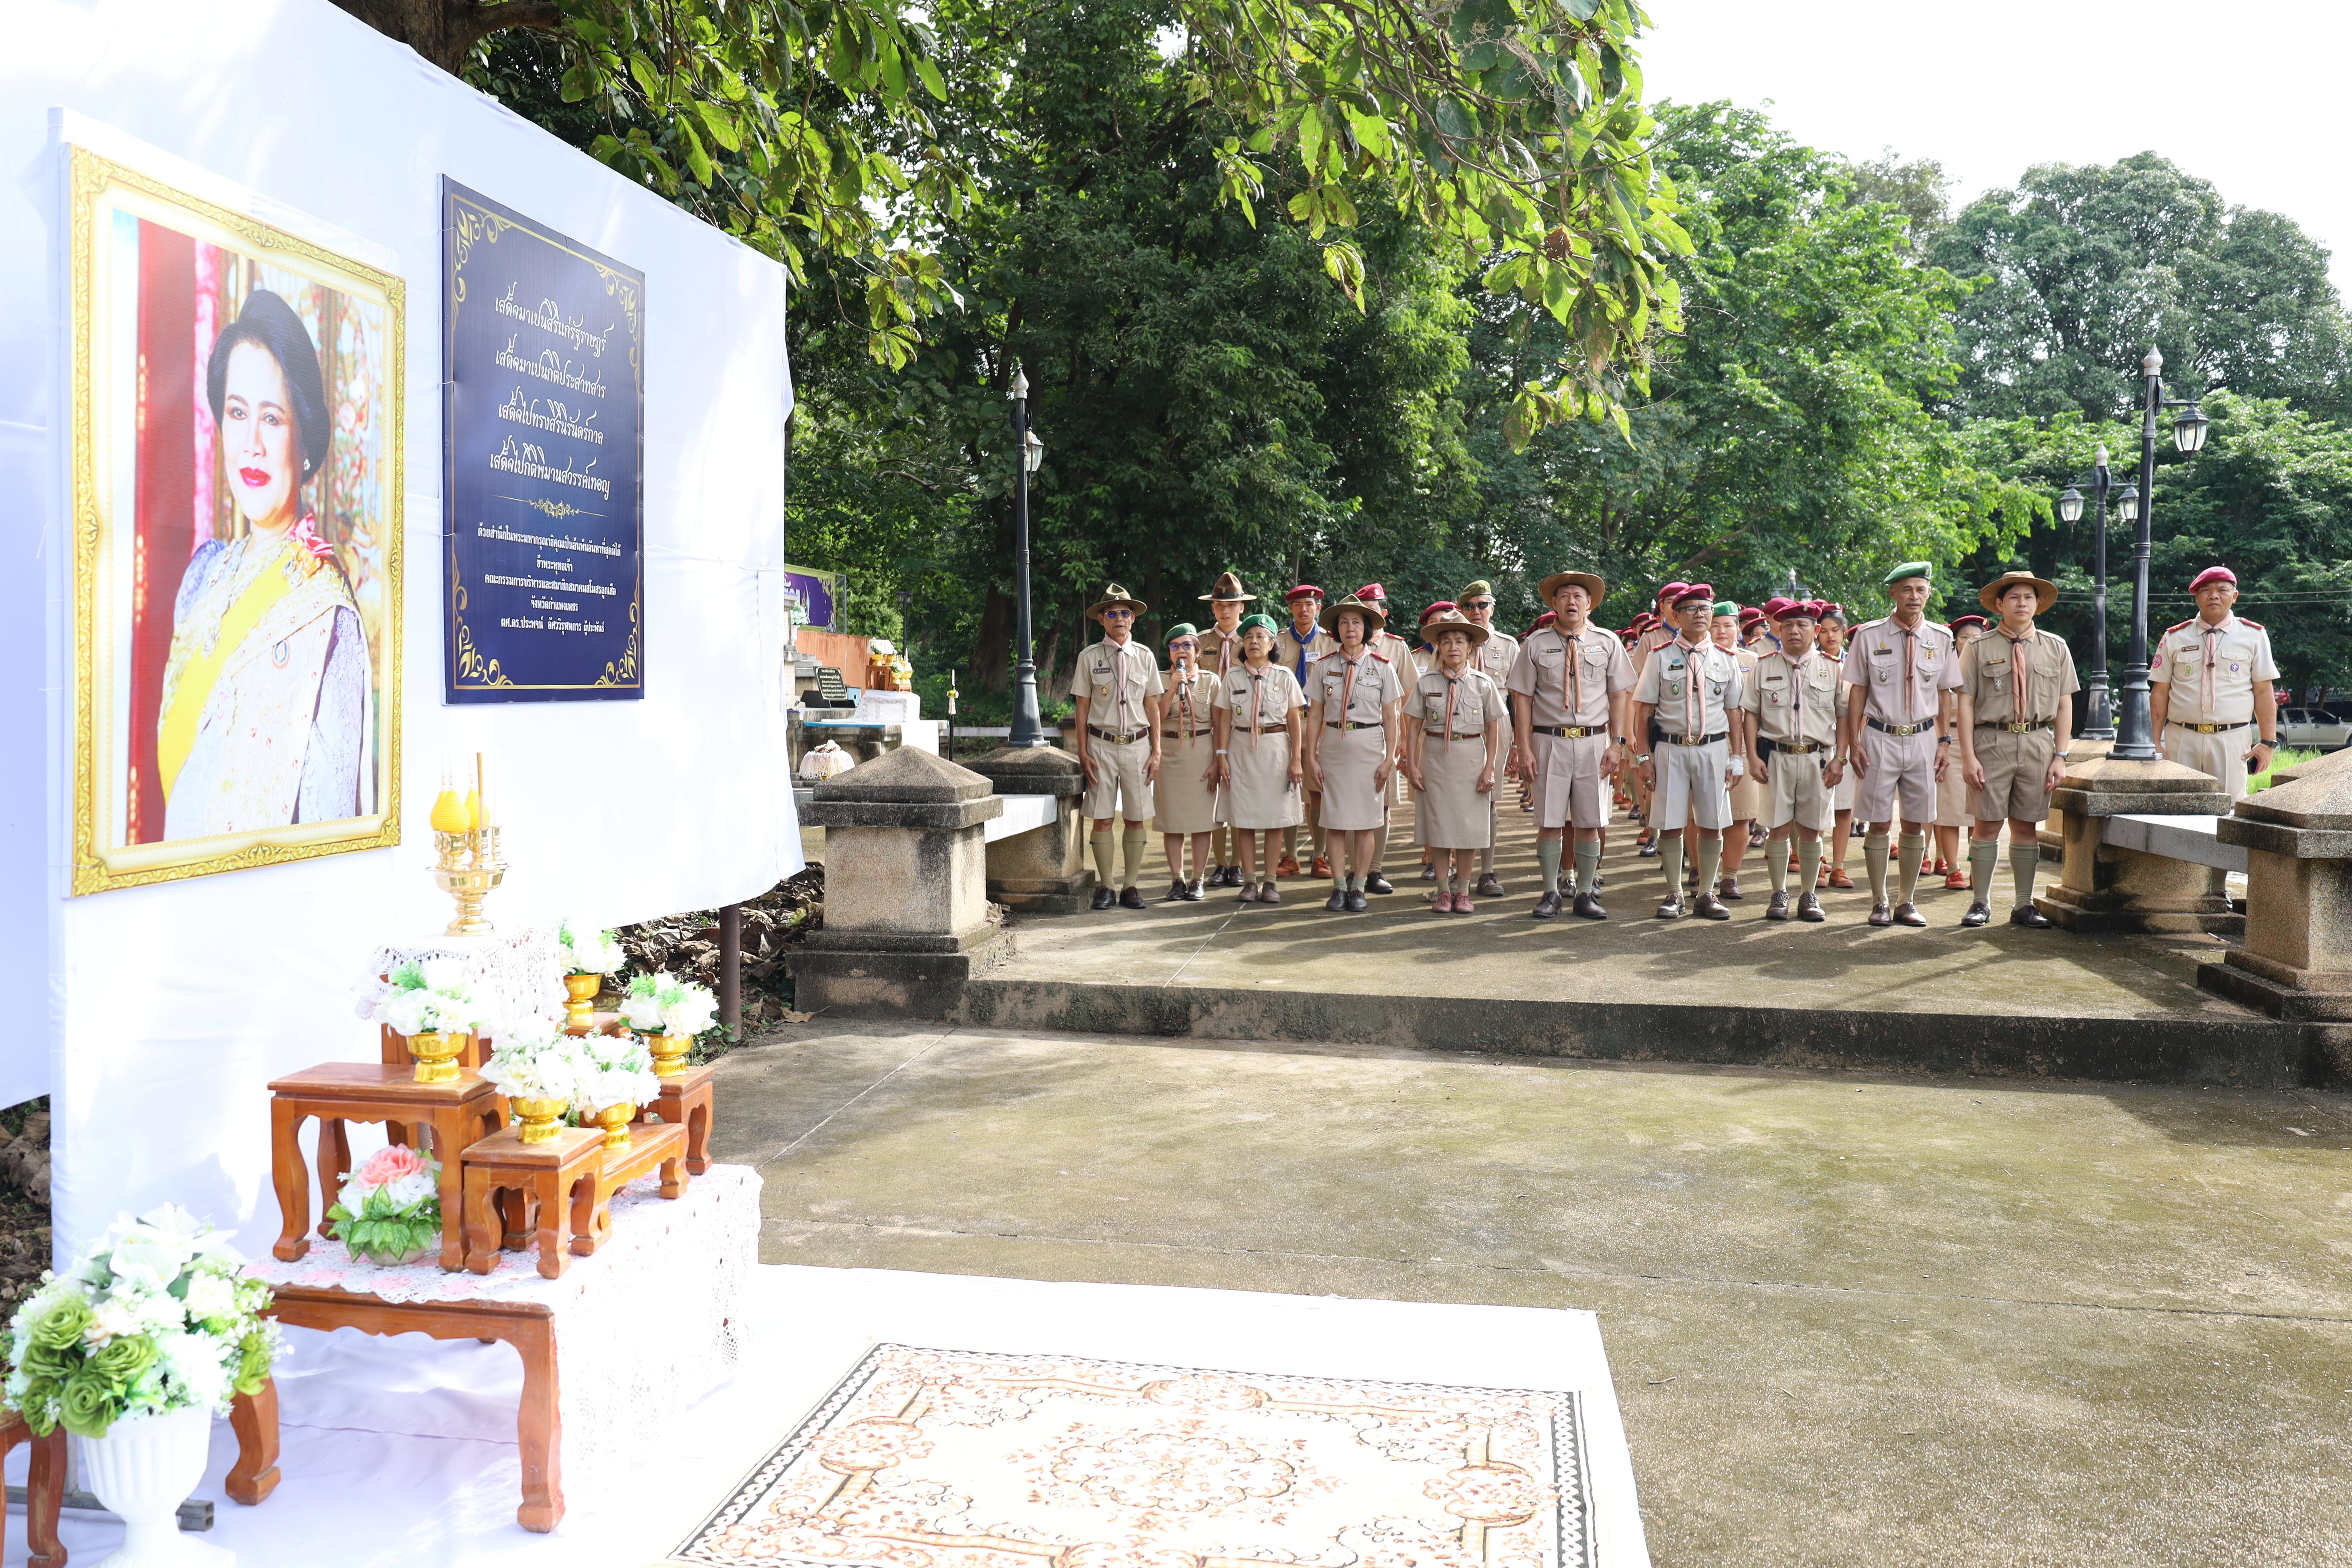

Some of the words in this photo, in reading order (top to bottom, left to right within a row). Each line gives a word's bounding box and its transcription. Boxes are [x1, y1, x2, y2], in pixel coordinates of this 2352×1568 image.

[536, 554, 573, 575] ข้าพระพุทธเจ้า
[484, 574, 617, 599] คณะกรรมการบริหารและสมาชิกสมาคมสโมสรลูกเสือ
[531, 595, 579, 612] จังหวัดกำแพงเพชร
[583, 620, 605, 636] ผู้ประพันธ์
